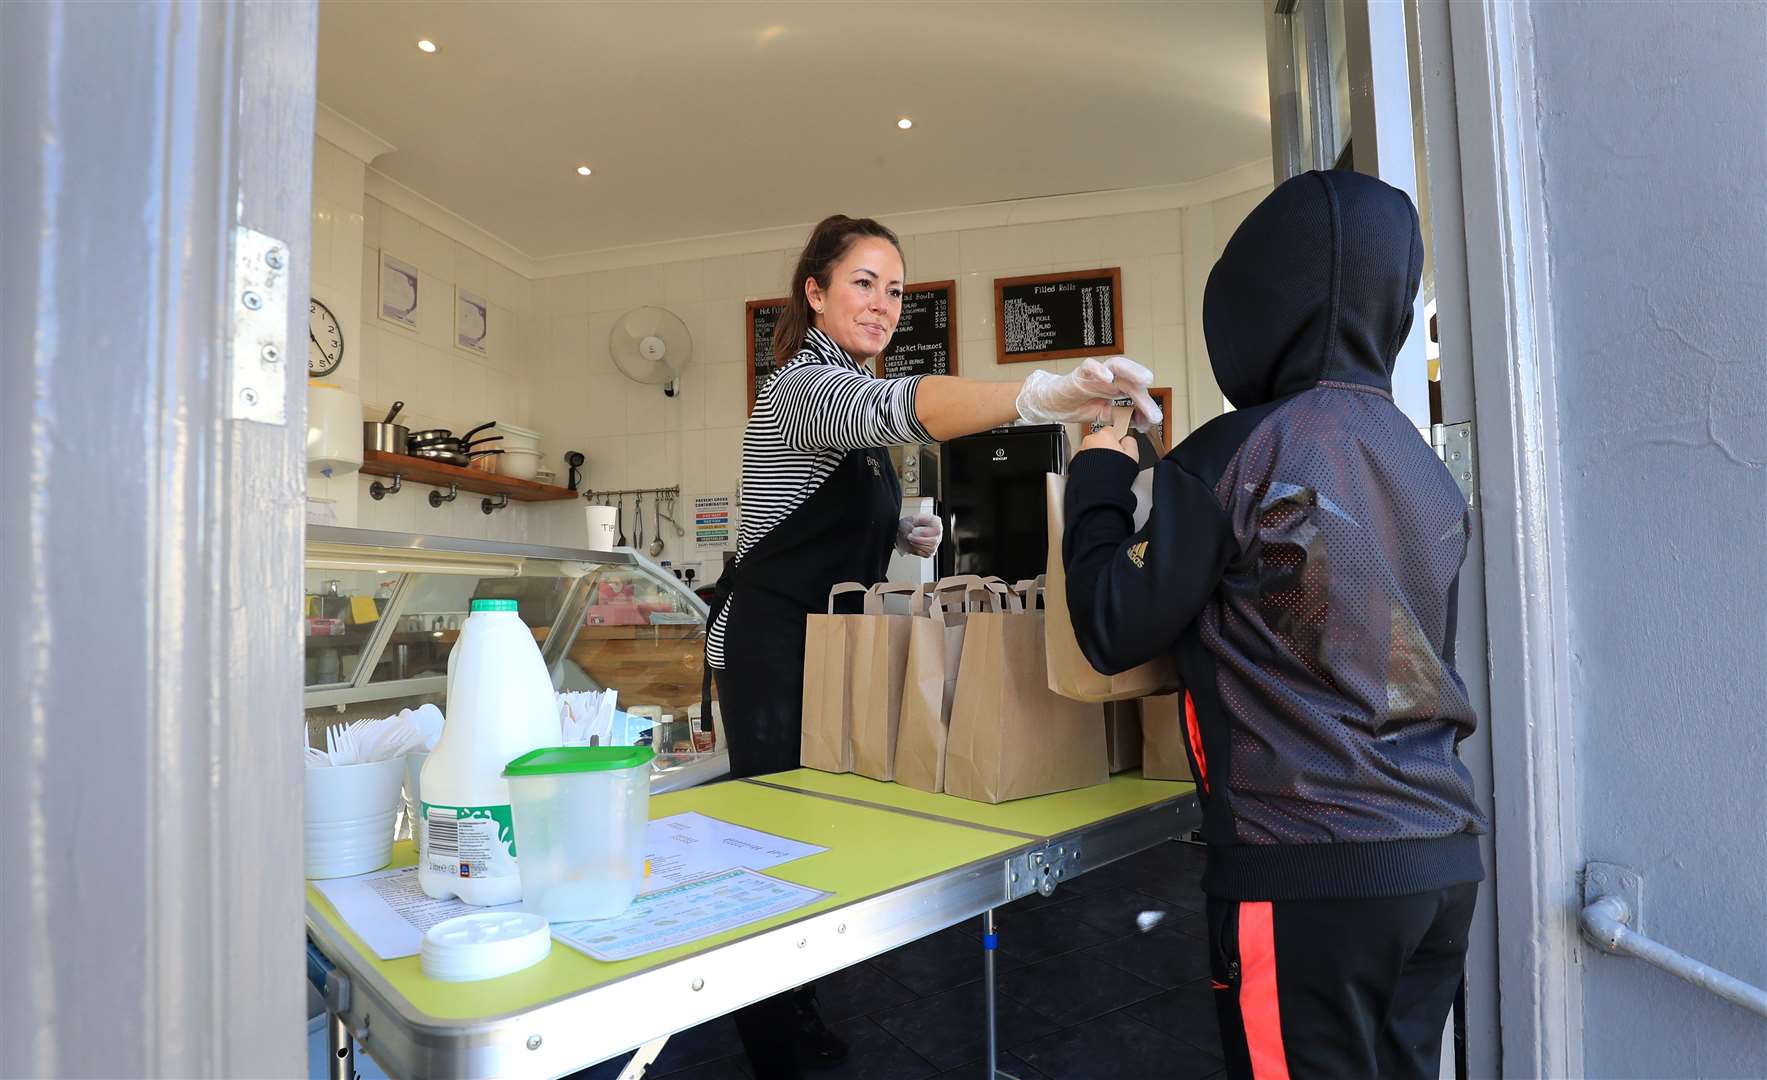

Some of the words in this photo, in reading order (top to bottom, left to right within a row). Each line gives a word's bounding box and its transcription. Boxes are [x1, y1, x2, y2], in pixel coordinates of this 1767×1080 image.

[1034, 285, 1056, 294] Filled
[328, 325, 335, 334] 2
[331, 340, 338, 348] 3
[895, 344, 916, 353] Jacket
[917, 343, 943, 351] Potatoes
[319, 359, 326, 368] 5
